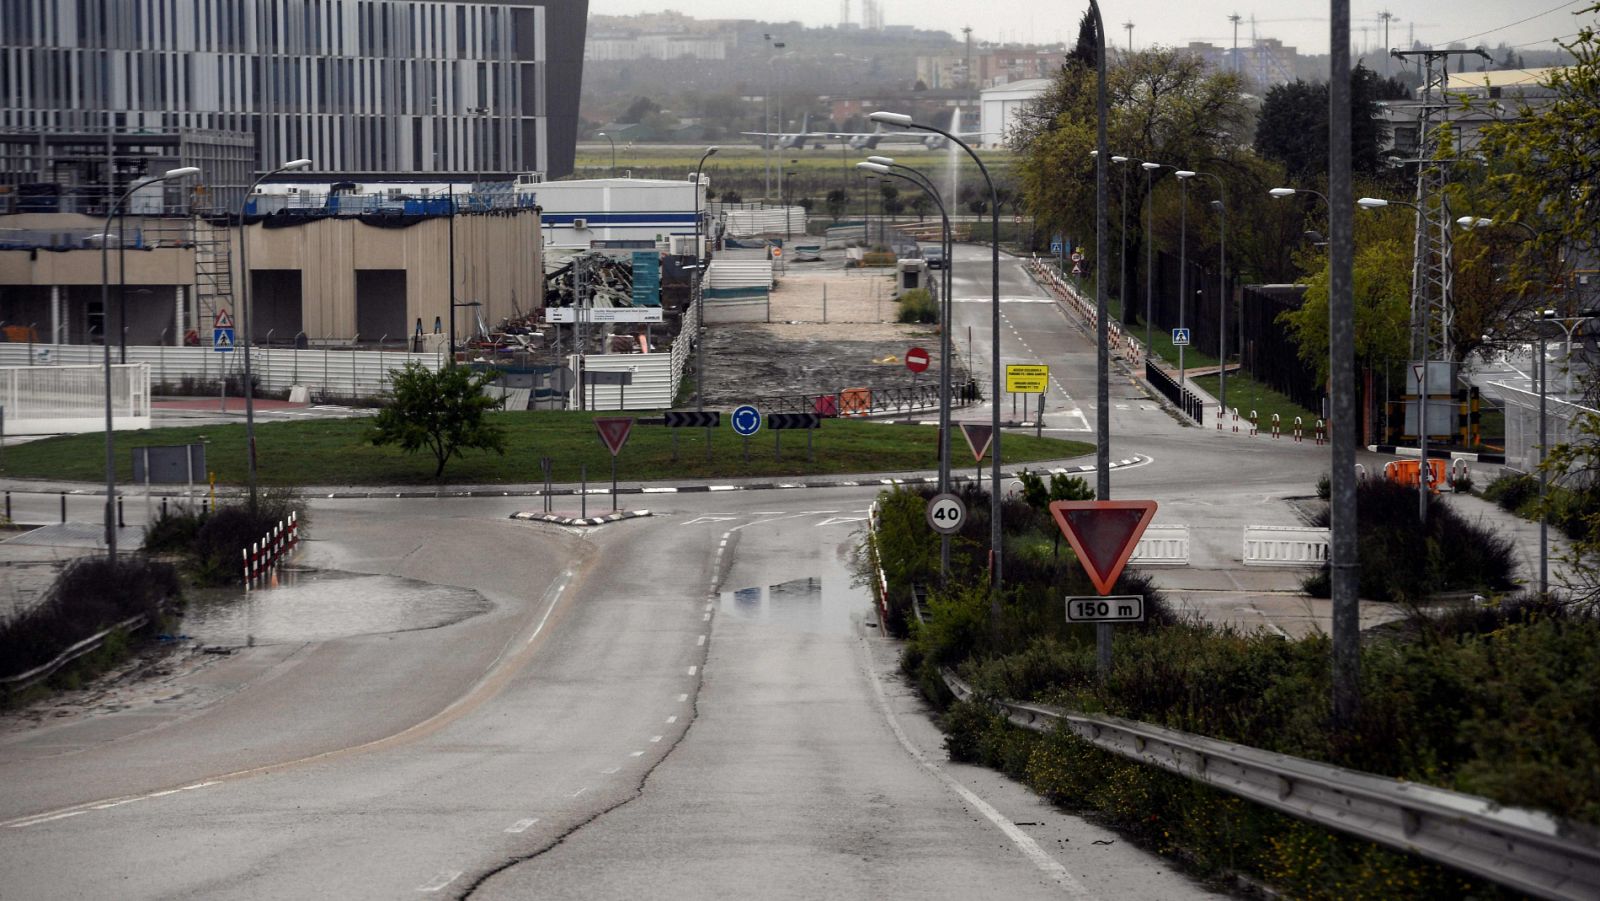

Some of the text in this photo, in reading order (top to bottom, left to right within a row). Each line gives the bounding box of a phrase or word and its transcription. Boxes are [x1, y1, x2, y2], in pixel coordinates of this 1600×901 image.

[934, 507, 959, 521] 40
[1077, 602, 1133, 617] 150 m
